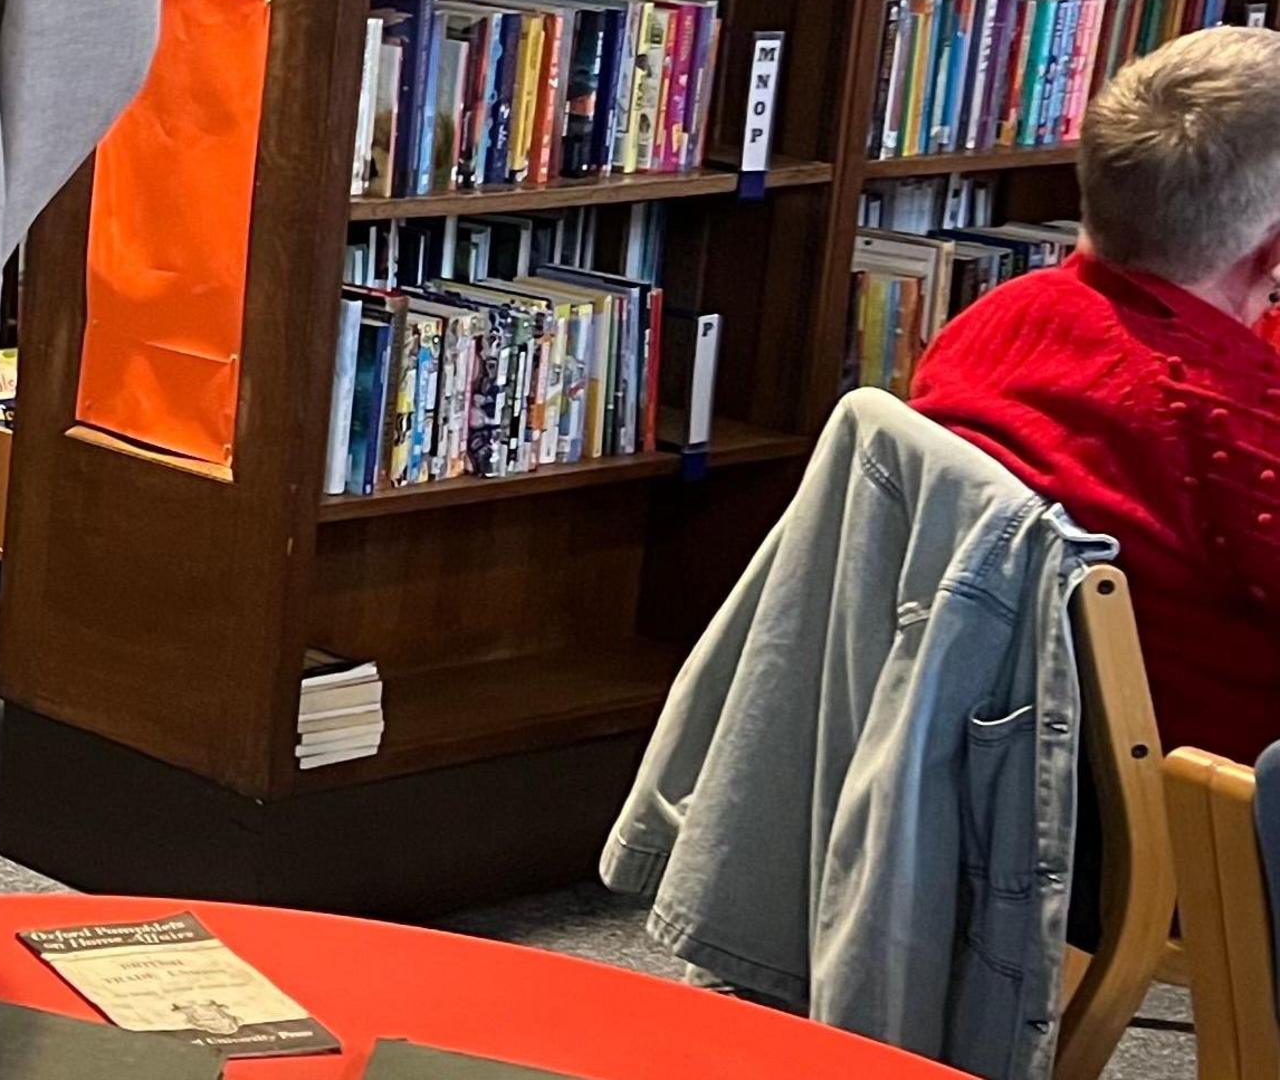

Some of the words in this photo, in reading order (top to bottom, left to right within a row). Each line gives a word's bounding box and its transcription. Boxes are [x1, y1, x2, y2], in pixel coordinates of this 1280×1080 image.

[758, 47, 776, 62] M
[756, 75, 771, 90] N
[753, 101, 766, 115] O
[749, 128, 763, 143] P
[701, 321, 714, 337] P
[30, 926, 92, 945] Oxford
[93, 920, 186, 938] Pamphlets
[42, 940, 65, 951] on
[68, 935, 122, 950] Home
[127, 929, 195, 946] Affairs
